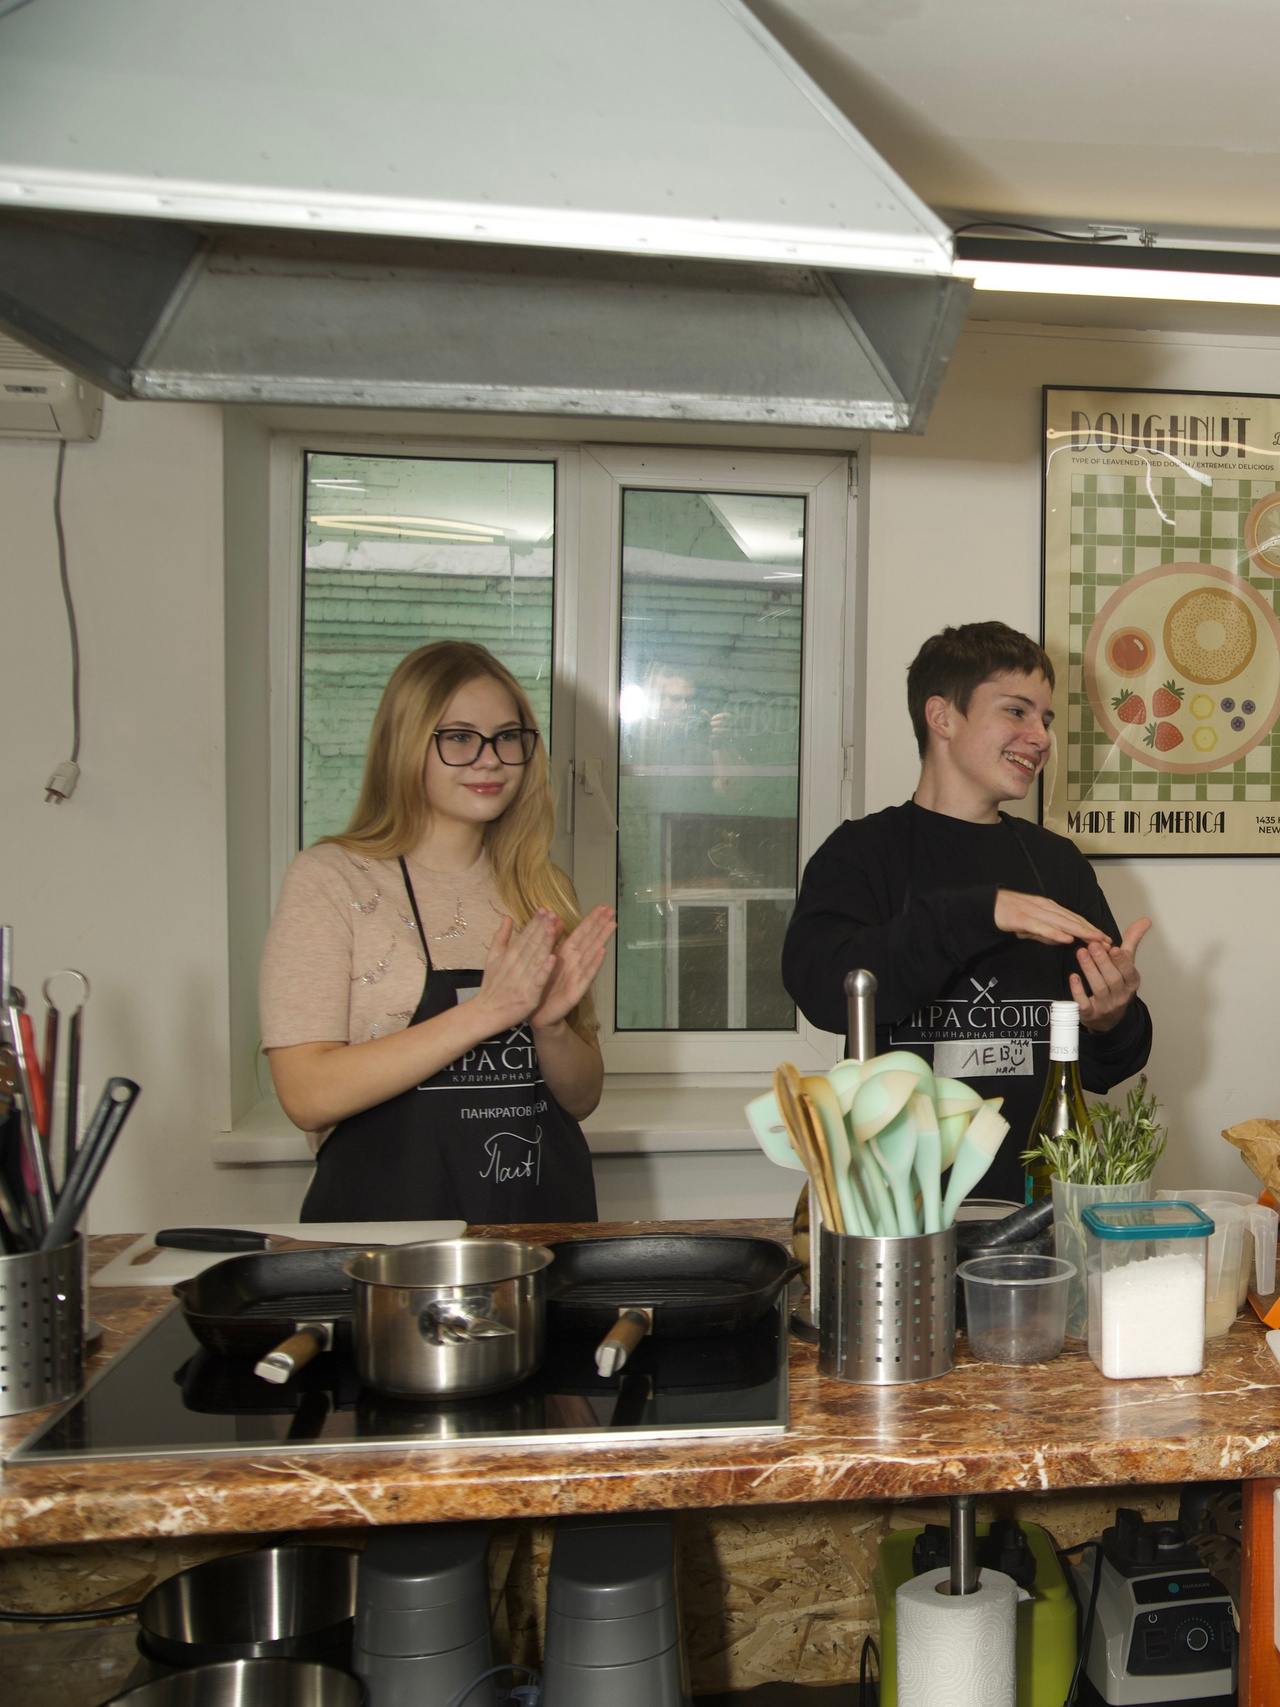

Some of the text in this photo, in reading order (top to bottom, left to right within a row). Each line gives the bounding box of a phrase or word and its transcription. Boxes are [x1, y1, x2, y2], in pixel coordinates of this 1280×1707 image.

[1071, 411, 1251, 458] DOUGHNUT
[1071, 457, 1088, 465] TYPE
[1238, 463, 1274, 471] DELICIOUS
[1067, 811, 1225, 833] MADE IN AMERICA
[1255, 816, 1276, 824] 1435
[968, 1005, 1051, 1028] СТОЛО
[921, 1030, 1039, 1039] КУЛИНАРНАЯ СТУДИЯ
[961, 1045, 1011, 1070] ЛЕВ
[452, 1072, 532, 1082] КУЛИНАРНАЯ
[461, 1105, 532, 1119] ПАНКРАТОВ
